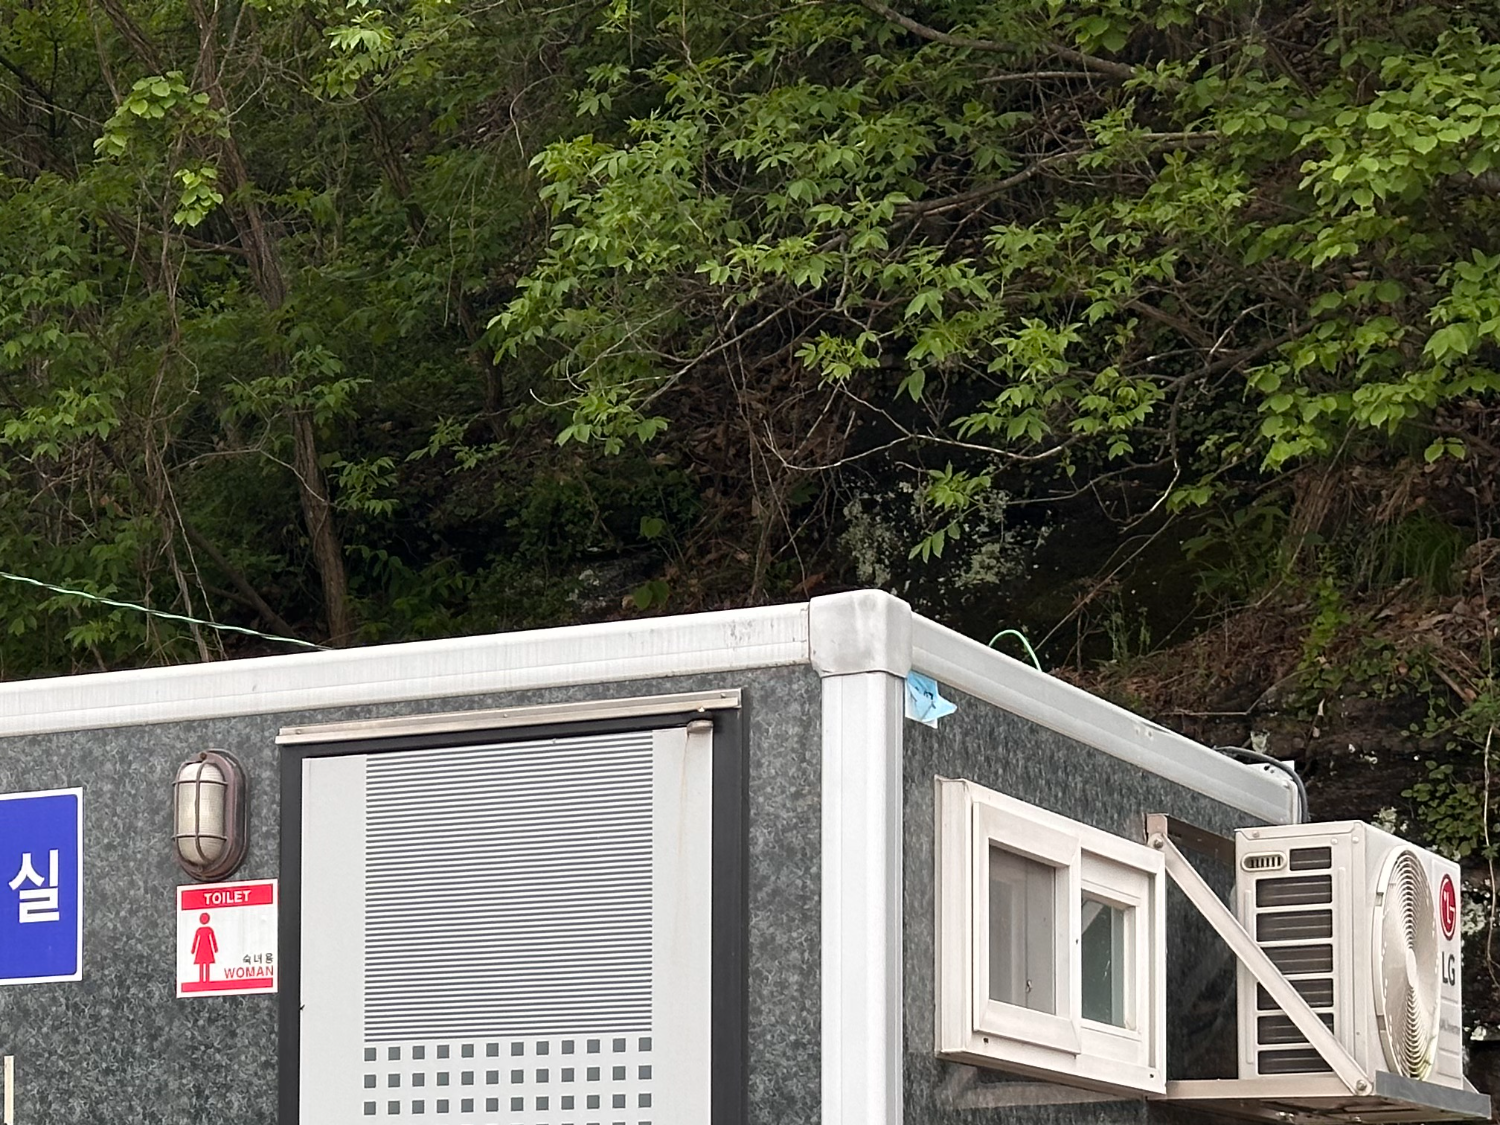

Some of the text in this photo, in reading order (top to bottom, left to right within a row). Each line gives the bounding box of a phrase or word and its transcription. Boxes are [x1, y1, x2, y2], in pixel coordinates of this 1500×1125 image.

[203, 890, 252, 905] TOILET
[224, 965, 274, 979] WOMAN
[1441, 951, 1456, 986] LG
